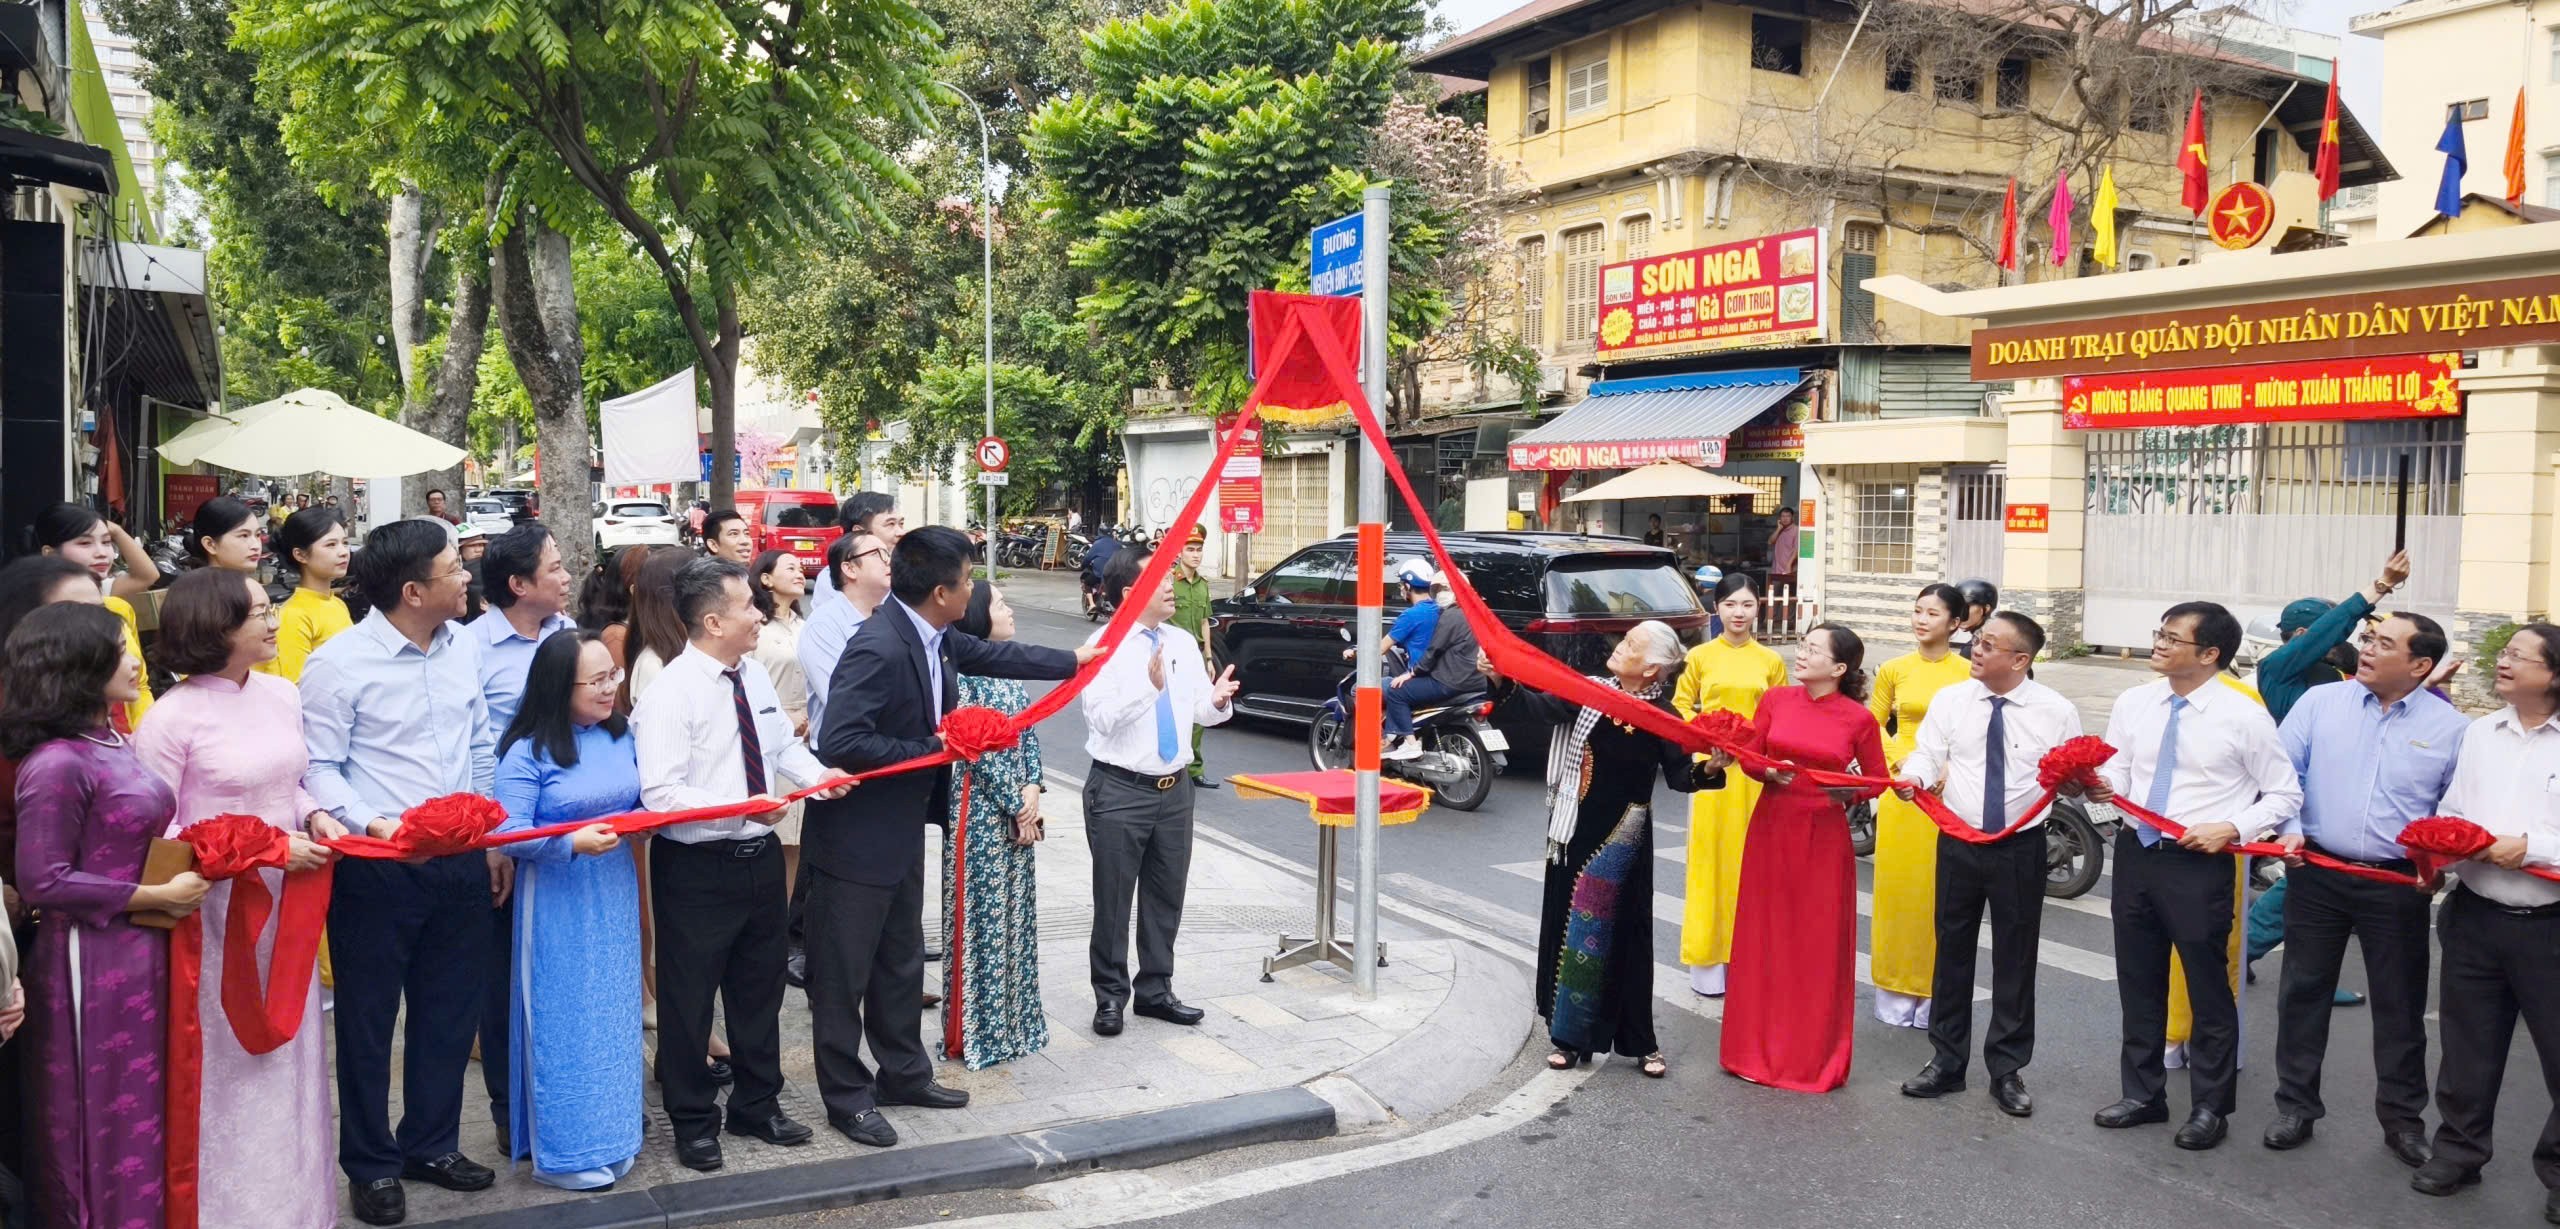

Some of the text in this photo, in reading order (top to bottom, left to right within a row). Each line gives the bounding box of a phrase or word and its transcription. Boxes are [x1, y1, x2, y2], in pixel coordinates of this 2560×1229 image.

[1322, 227, 1357, 257] ĐƯỜNG
[1641, 247, 1762, 296] SƠN NGA
[1700, 293, 1720, 321] Gà
[1726, 290, 1771, 314] CƠM TRƯA
[1749, 335, 1772, 344] 0904
[1774, 332, 1791, 341] 755
[1988, 336, 2067, 365] DOANH
[2071, 330, 2126, 362] TRẠI
[2130, 320, 2201, 360] QUÂN
[2204, 314, 2255, 354] ĐỘI
[2258, 307, 2341, 345] NHÂN
[2346, 301, 2412, 339] DÂN
[2418, 294, 2494, 337] VIỆT
[2091, 366, 2421, 415] MỪNG ĐẢNG QUANG VINH MỪNG XUÂN THẮNG LỢI
[1549, 444, 1582, 467] SƠN
[1586, 446, 1621, 466] NGA
